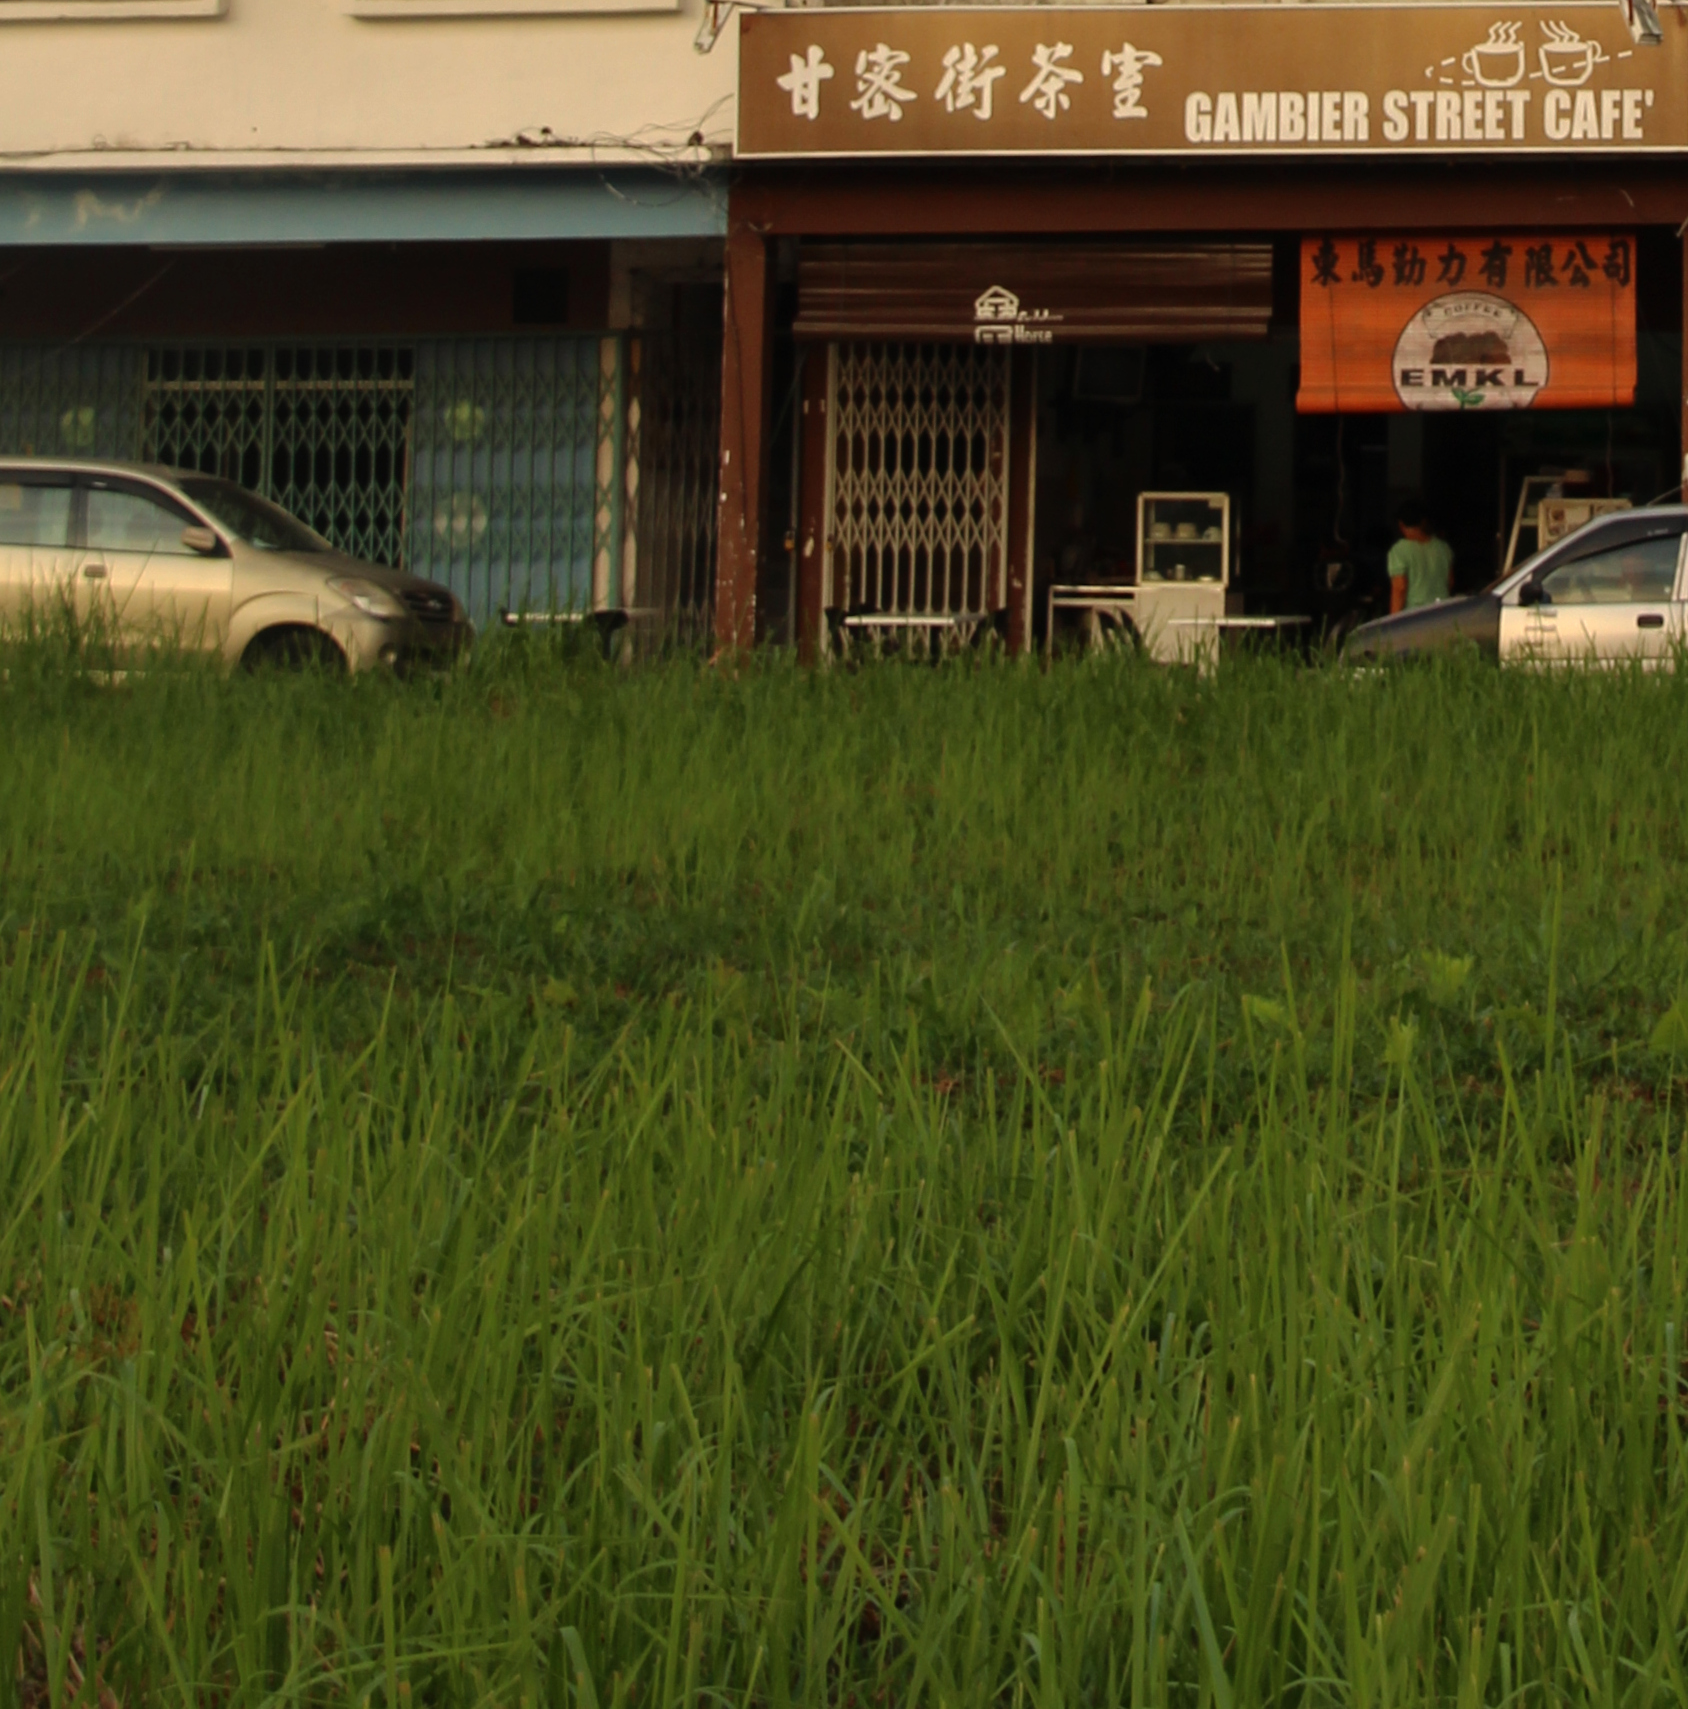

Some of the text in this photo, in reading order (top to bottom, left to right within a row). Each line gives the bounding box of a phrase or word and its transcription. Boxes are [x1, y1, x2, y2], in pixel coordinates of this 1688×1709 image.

[776, 41, 1163, 121] 甘密街茶室
[1185, 88, 1654, 143] GAMBIER STREET CAFE'
[1443, 302, 1504, 318] COFFEE
[1400, 368, 1539, 388] EMKL
